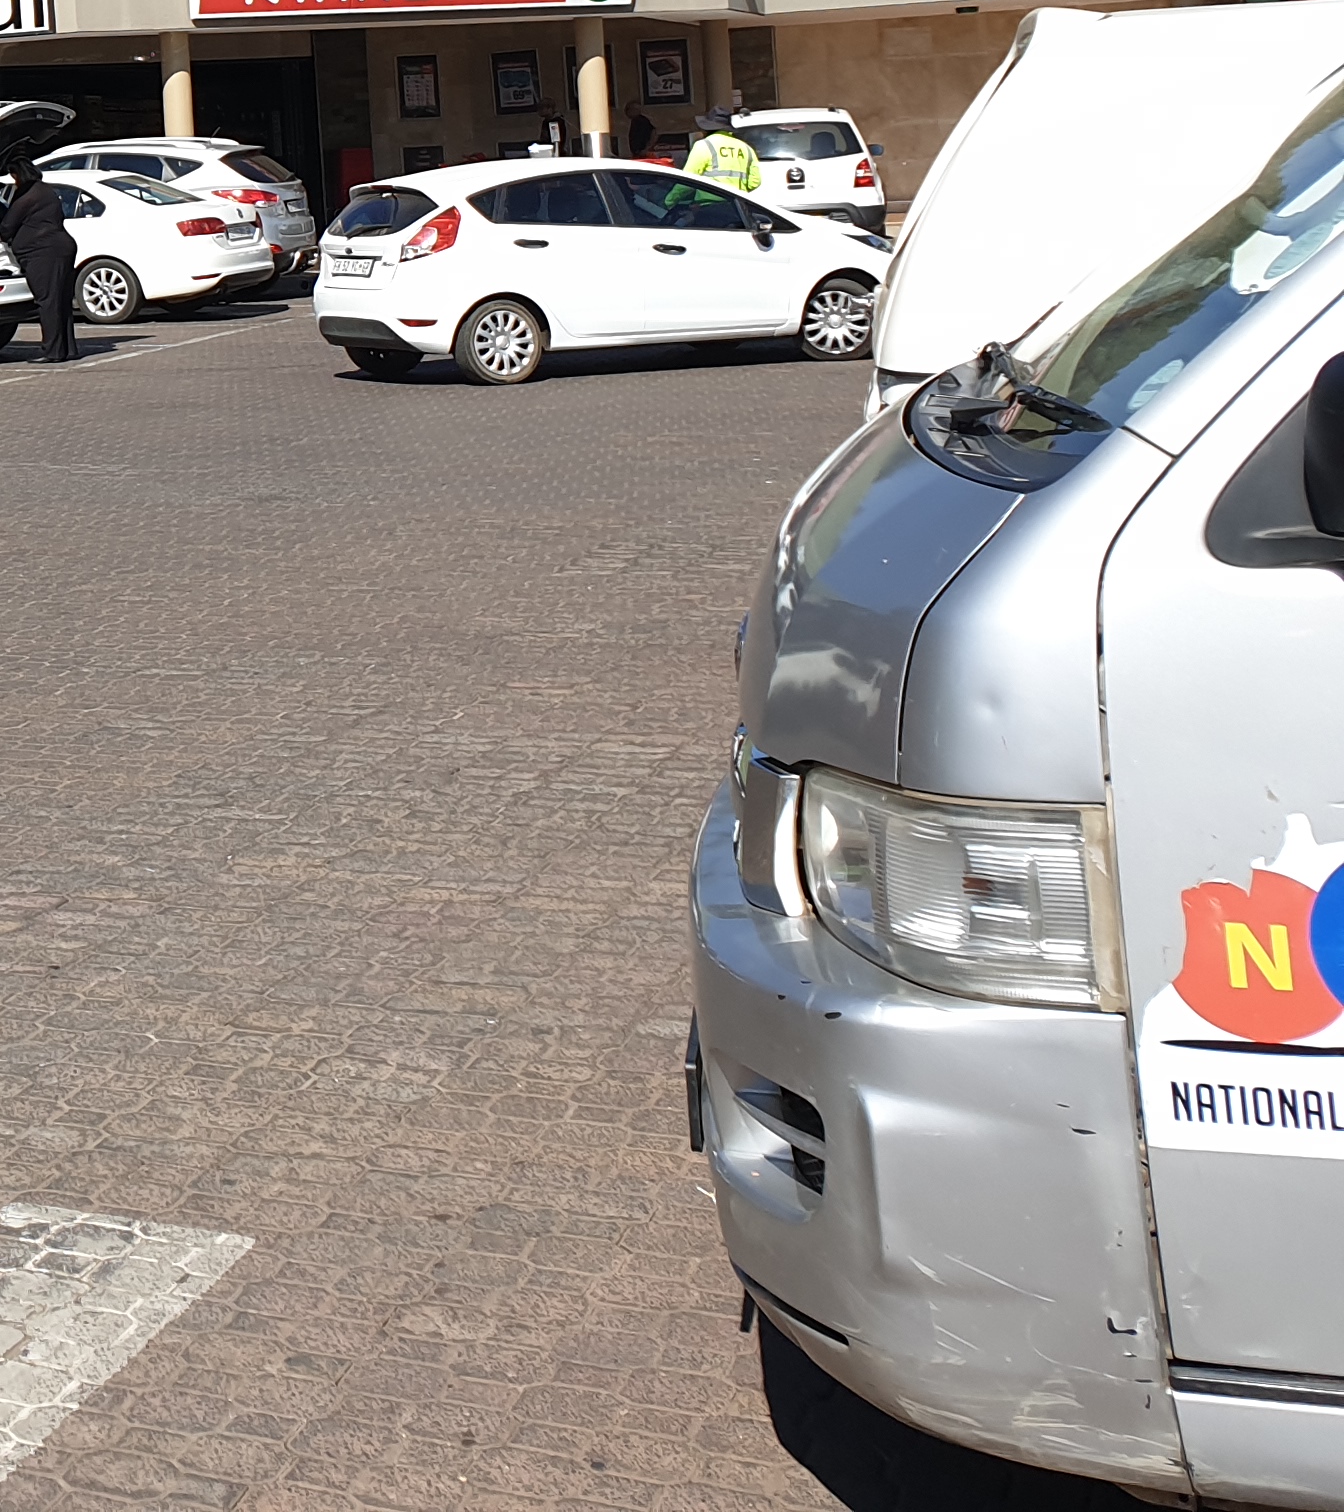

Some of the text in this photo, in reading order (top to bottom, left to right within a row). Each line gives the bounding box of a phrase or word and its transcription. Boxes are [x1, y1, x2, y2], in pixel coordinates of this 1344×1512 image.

[719, 147, 744, 159] CTA
[1224, 922, 1293, 991] N
[1170, 1081, 1344, 1132] NATIONAL
